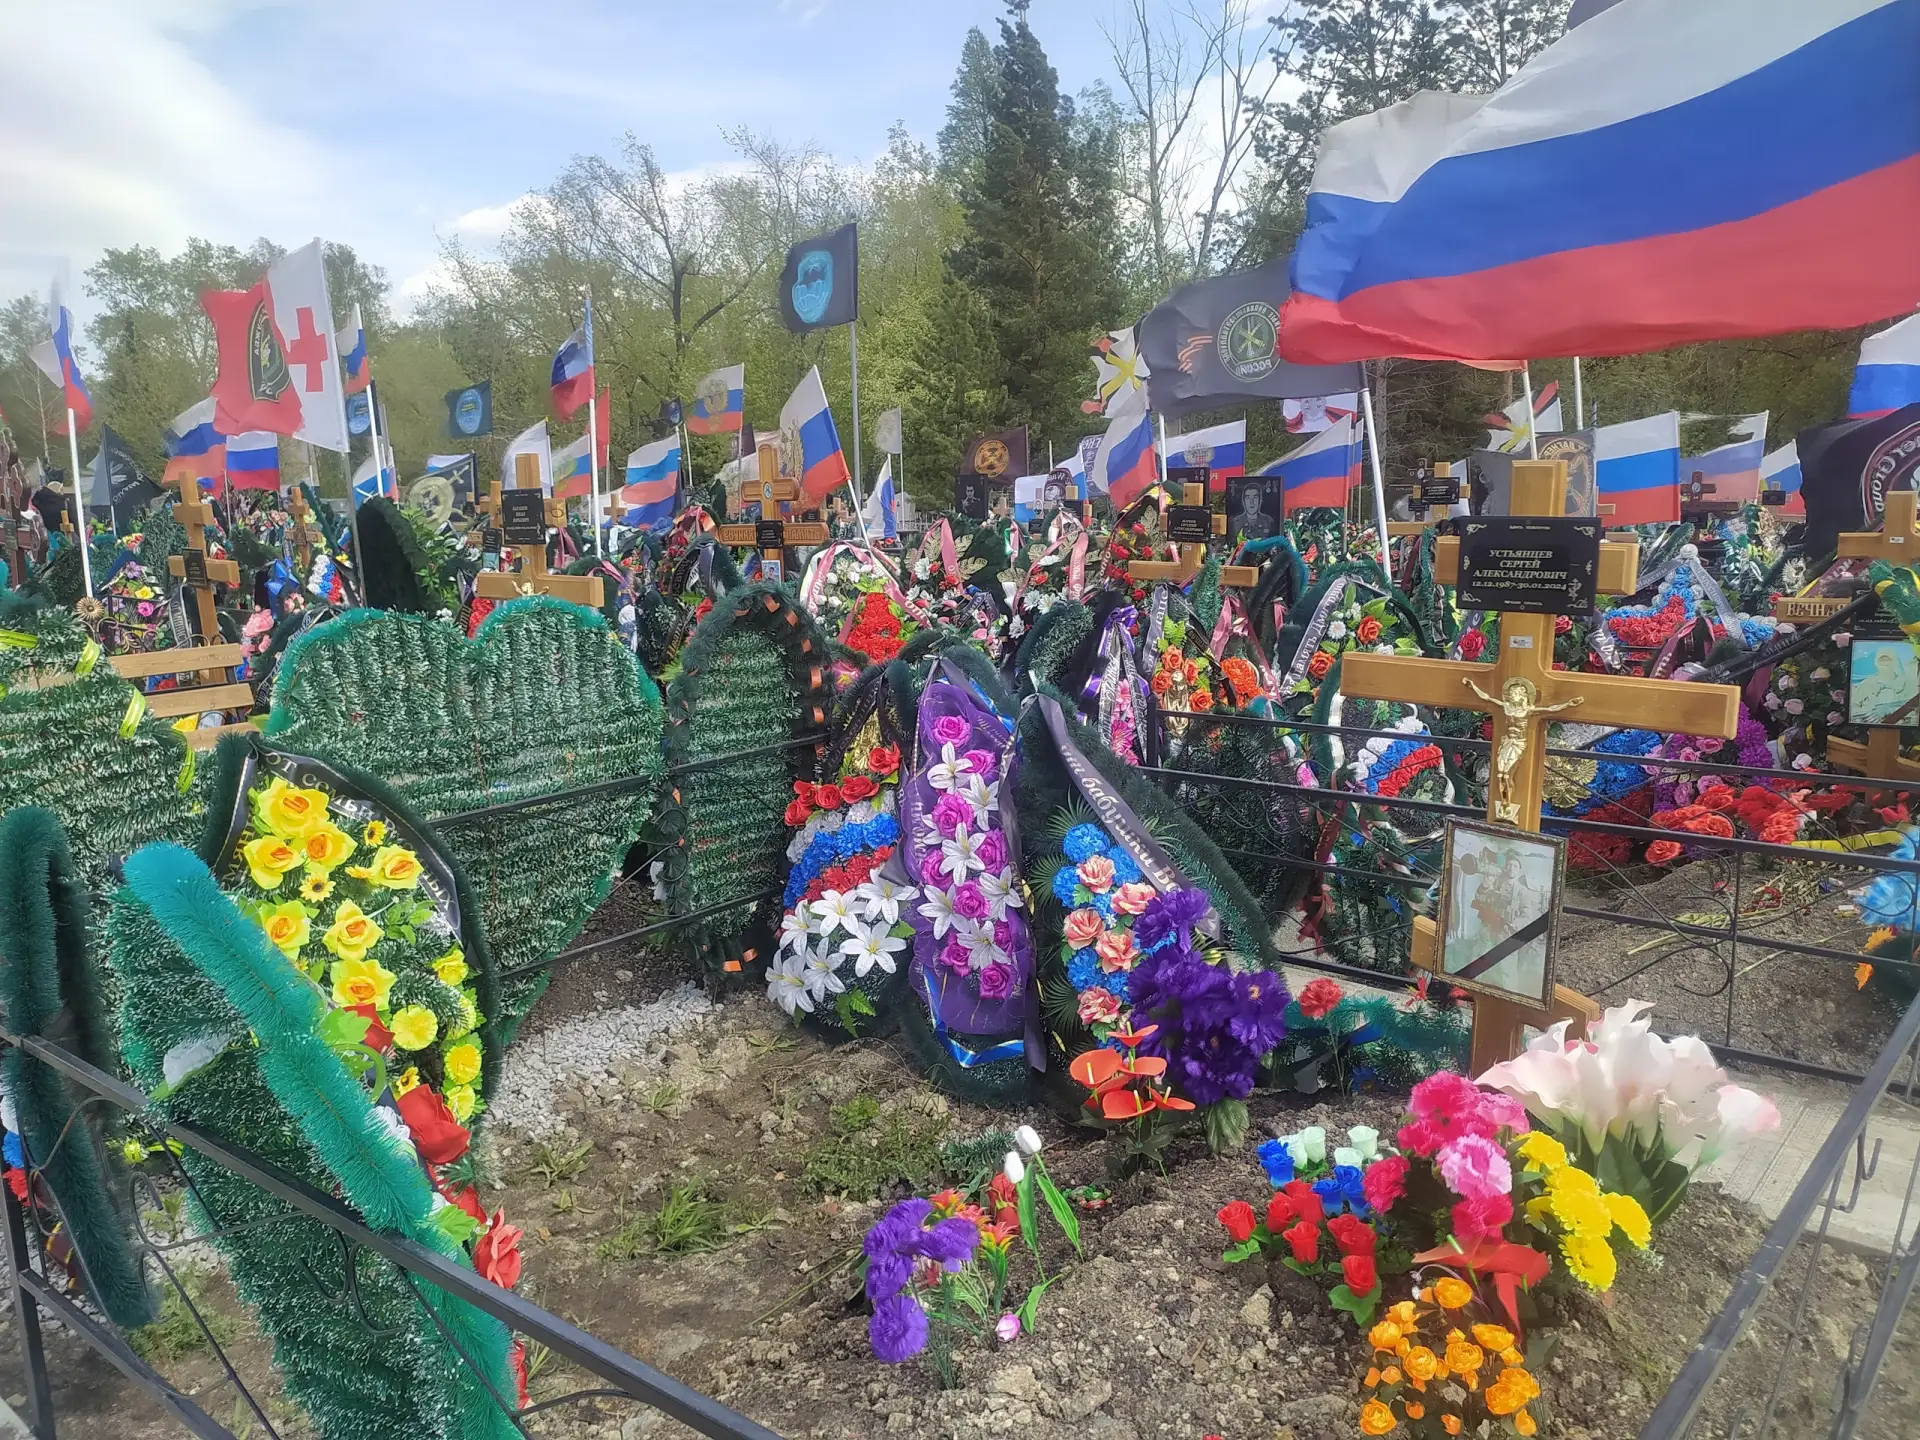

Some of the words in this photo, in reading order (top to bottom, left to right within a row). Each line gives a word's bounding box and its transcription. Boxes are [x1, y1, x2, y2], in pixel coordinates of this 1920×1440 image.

[1489, 549, 1553, 559] УСТЬЯНЦЕВ
[1500, 558, 1542, 569] СЕРГЕЙ
[1473, 569, 1567, 580] АЛЕКСАНДРОВИЧ
[1081, 777, 1157, 868] бабушки
